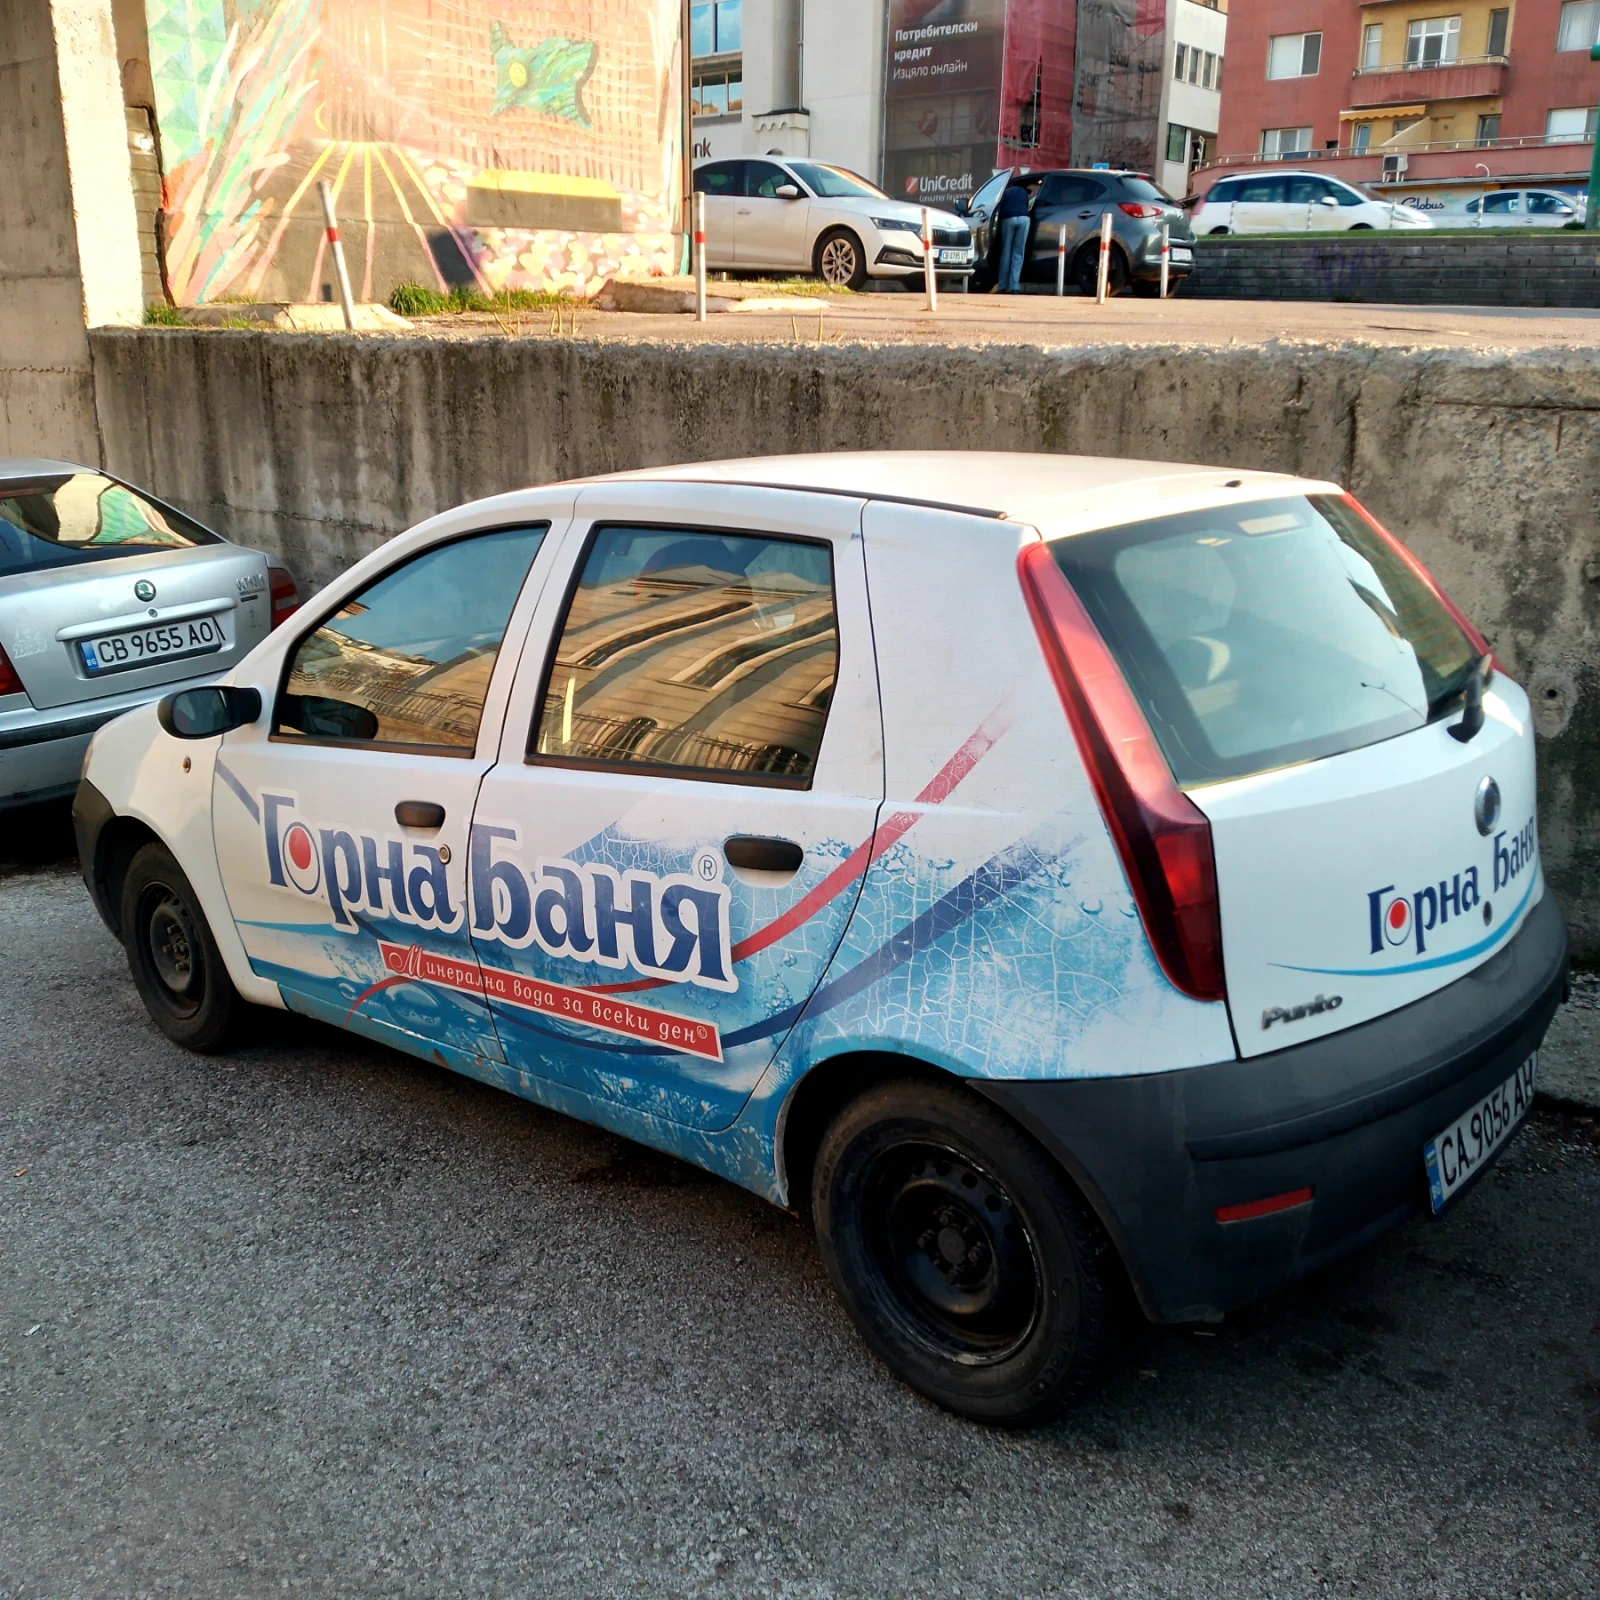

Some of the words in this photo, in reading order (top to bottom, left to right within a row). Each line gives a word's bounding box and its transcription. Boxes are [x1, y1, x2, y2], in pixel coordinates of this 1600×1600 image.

[895, 21, 978, 42] Потребителски
[894, 46, 933, 62] кредит
[893, 66, 929, 80] Изцяло
[931, 59, 968, 75] онлайн
[692, 136, 712, 158] nk
[920, 173, 973, 192] UniCredit
[1401, 197, 1445, 210] Globus
[98, 638, 129, 663] CB
[131, 627, 184, 656] 9655
[188, 622, 214, 646] AO
[86, 658, 97, 667] BG
[261, 793, 458, 927] Горна
[1367, 865, 1481, 954] Горна
[1493, 815, 1535, 894] Баня
[389, 943, 506, 993] Минерална
[513, 979, 555, 1007] вода
[562, 996, 584, 1014] за
[592, 1000, 650, 1031] всеки
[1262, 993, 1344, 1030] Punto
[1441, 1126, 1470, 1187] CA
[1471, 1084, 1511, 1160] 9056
[1514, 1058, 1535, 1117] AH
